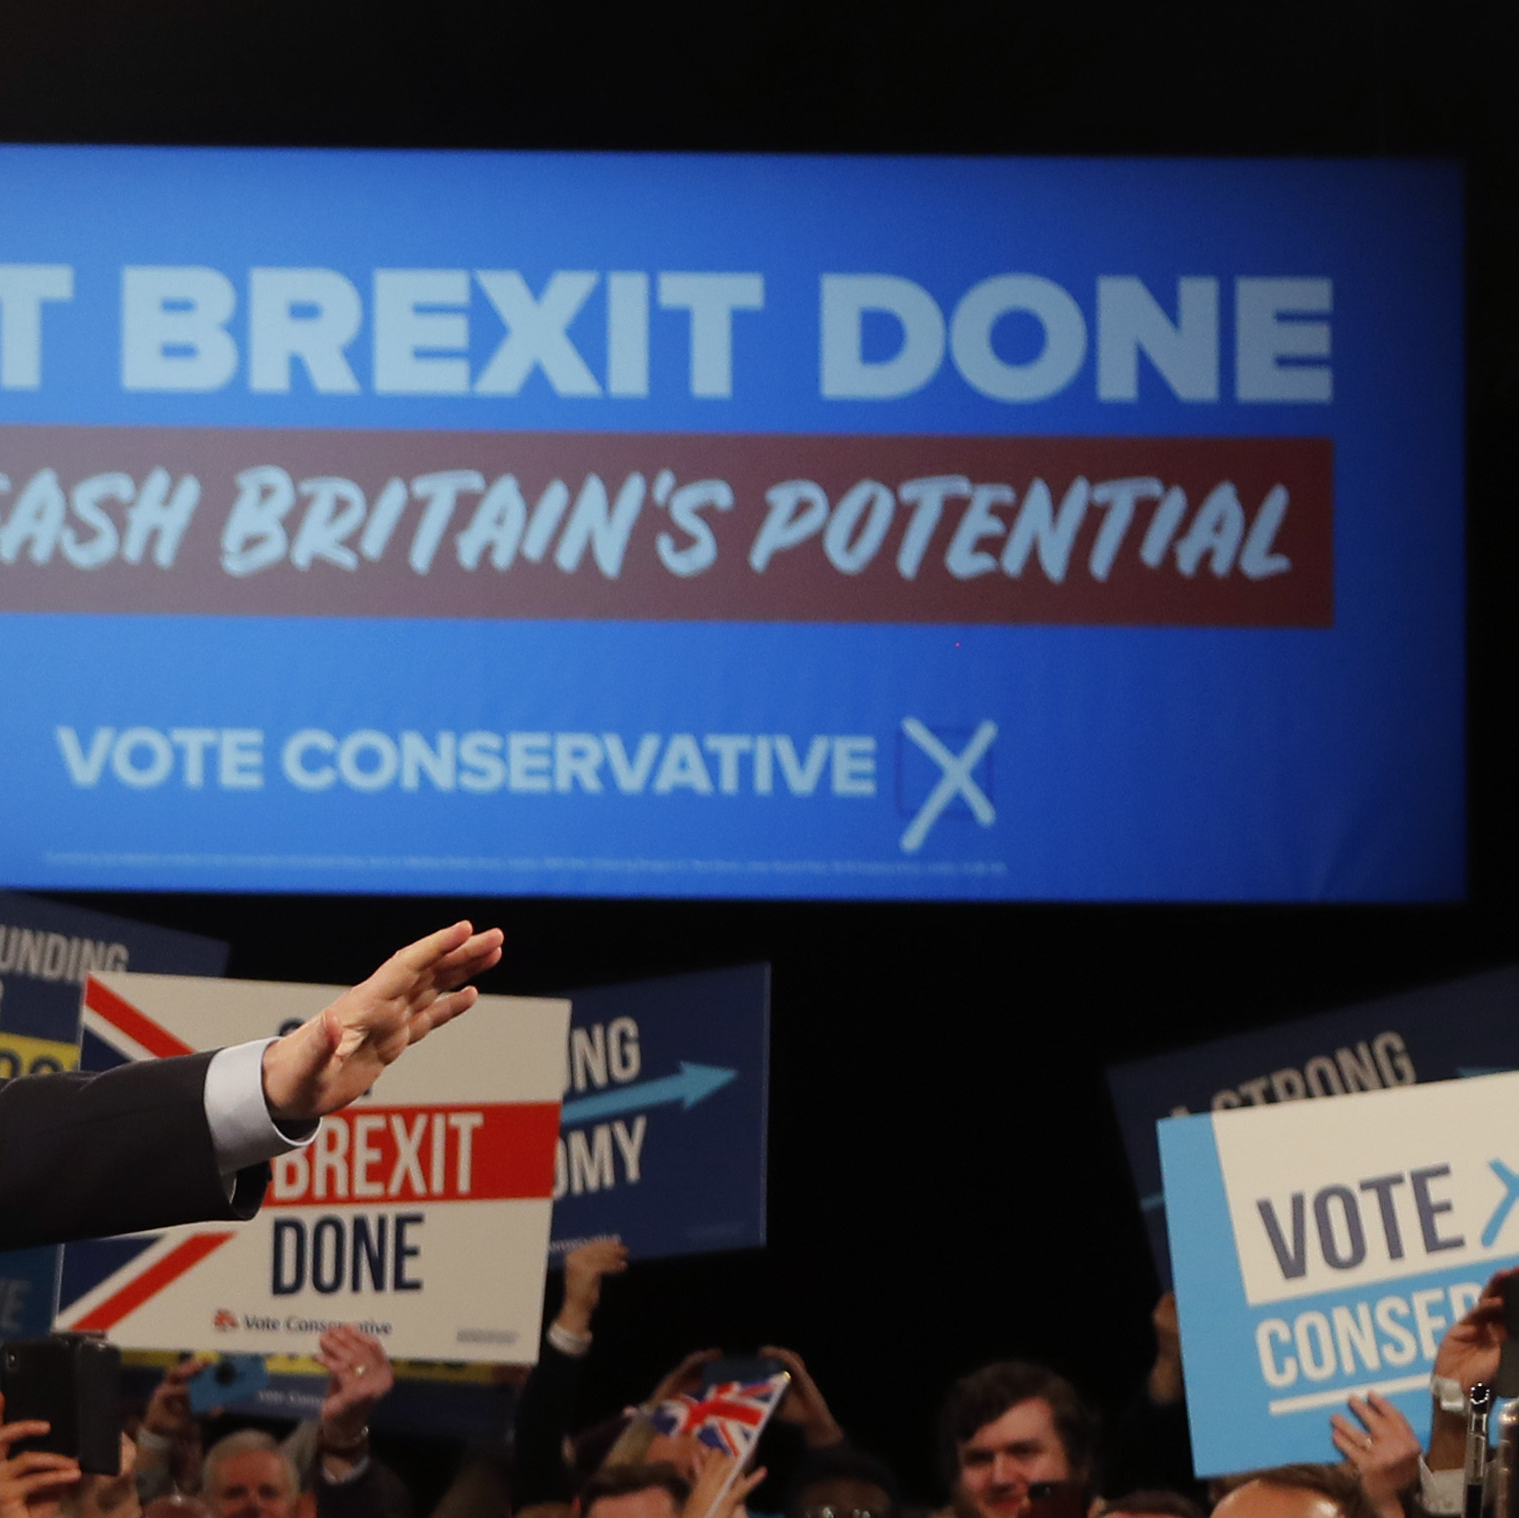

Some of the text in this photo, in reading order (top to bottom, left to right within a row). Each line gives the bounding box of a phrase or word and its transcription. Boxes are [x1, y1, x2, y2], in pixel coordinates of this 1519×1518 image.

[121, 265, 764, 398] BREXIT
[818, 272, 1334, 402] DONE
[220, 464, 734, 580] BRITAIN'S
[749, 473, 1292, 584] POTENTIAL
[55, 725, 877, 796] VOTE CONSERVATIVE
[272, 1112, 485, 1200] BREXIT
[272, 1212, 426, 1296] DONE
[1256, 1163, 1466, 1282] VOTE
[244, 1314, 282, 1331] Vote
